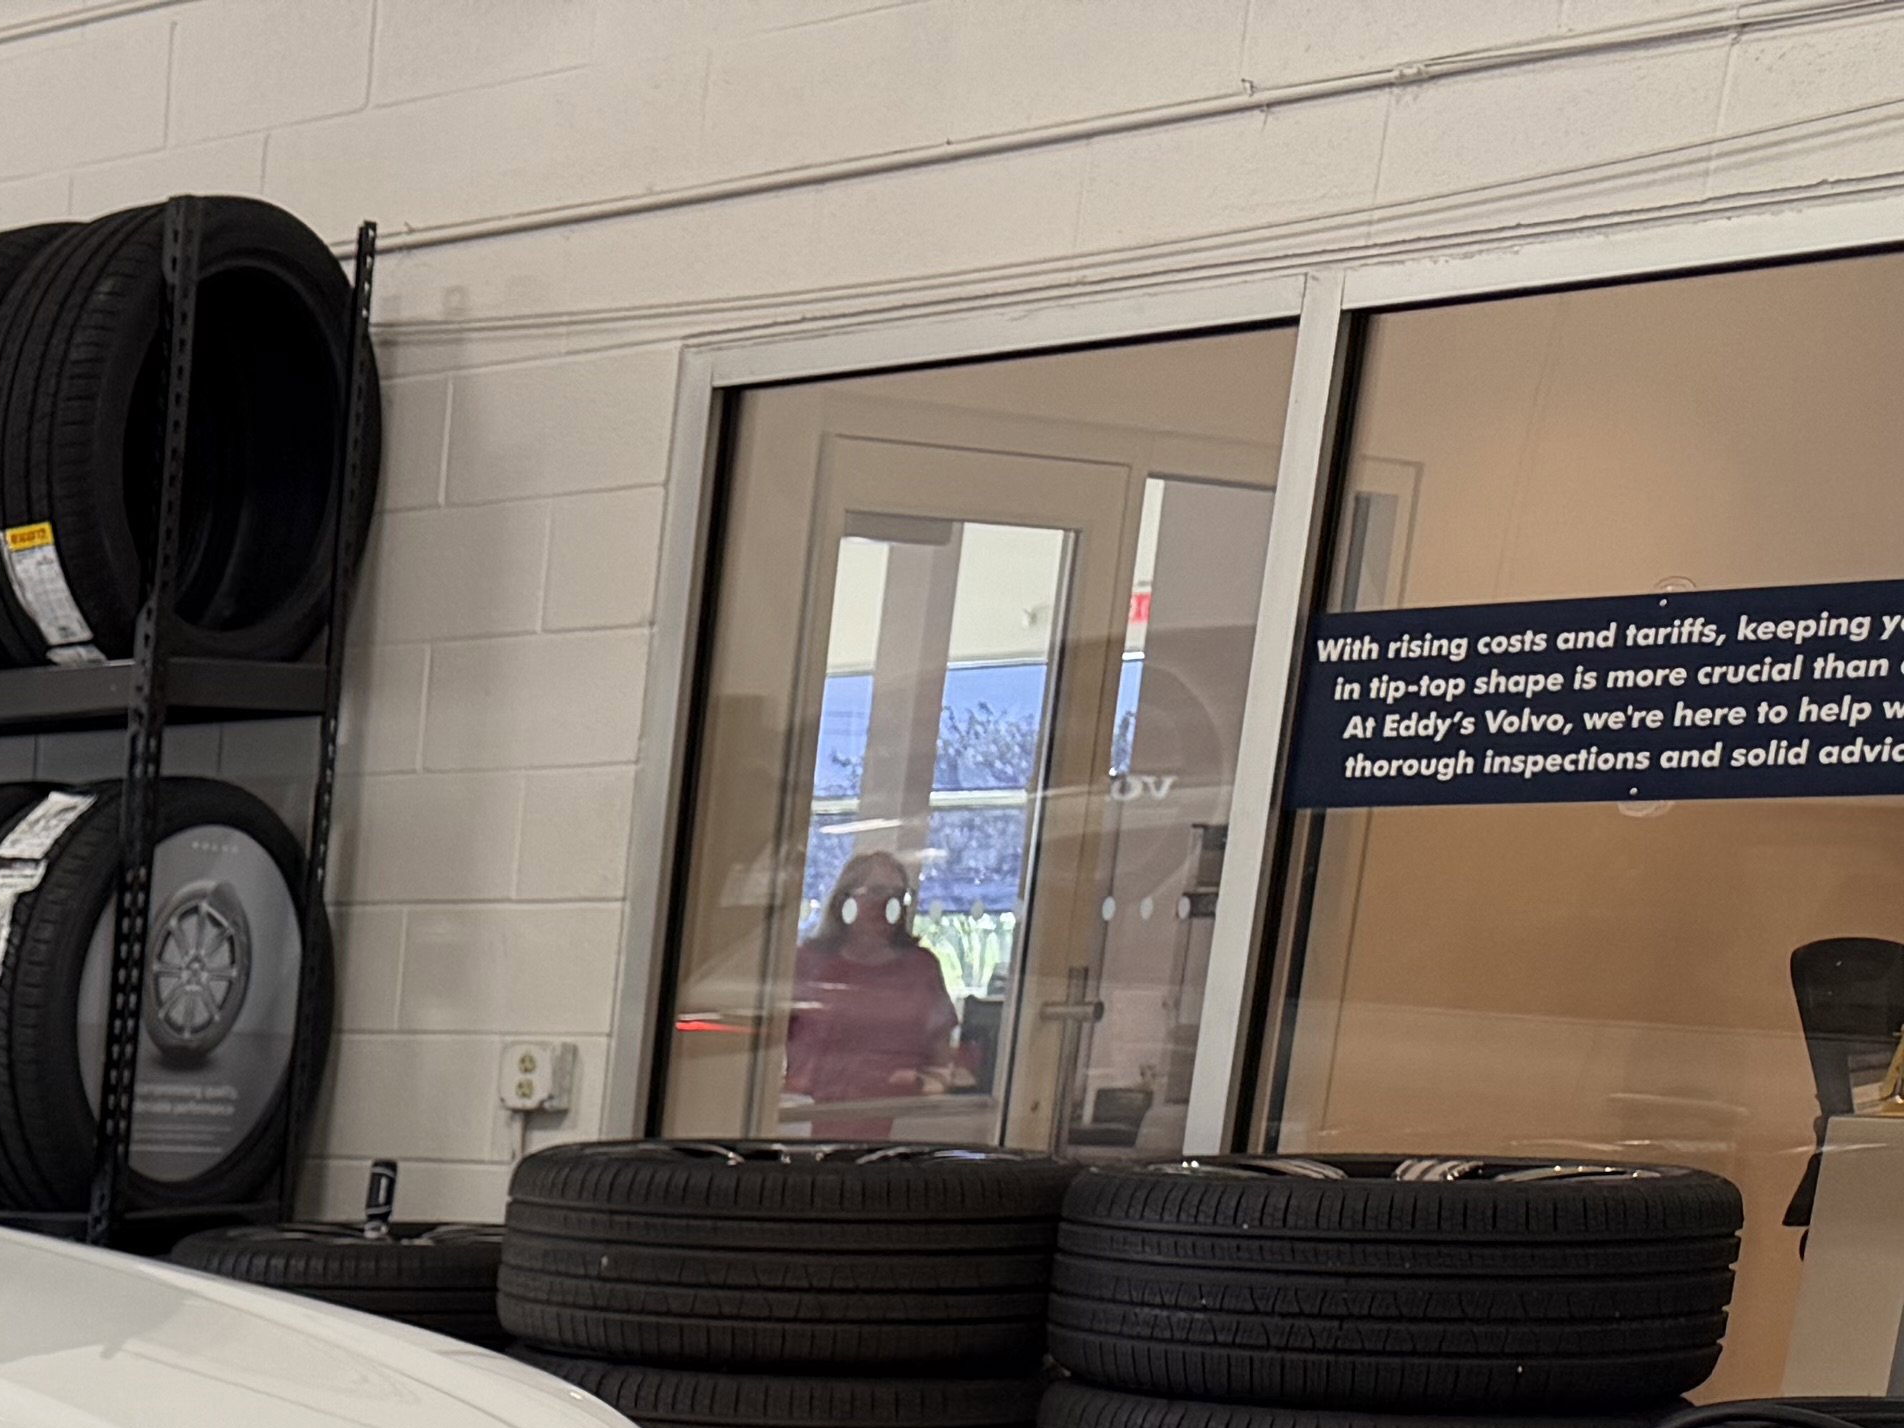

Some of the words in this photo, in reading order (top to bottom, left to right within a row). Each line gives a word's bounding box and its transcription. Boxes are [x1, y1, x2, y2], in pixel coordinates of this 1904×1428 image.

[1317, 635, 1380, 662] With
[1387, 632, 1469, 662] rising
[1476, 629, 1548, 655] costs
[1556, 621, 1617, 651] and
[1625, 617, 1727, 647] tariffs,
[1737, 610, 1872, 645] keeping
[1880, 614, 1904, 641] y
[1334, 676, 1361, 701] in
[1369, 674, 1466, 705] tip-top
[1473, 668, 1565, 699] shape
[1573, 665, 1598, 690] is
[1606, 667, 1688, 688] more
[1697, 654, 1804, 685] crucial
[1813, 652, 1889, 680] than
[1342, 715, 1376, 739] At
[1484, 707, 1573, 736] Volvo,
[1583, 704, 1664, 730] we're
[1673, 700, 1747, 727] here
[1757, 701, 1789, 724] to
[1798, 694, 1872, 727] help
[1345, 749, 1475, 781] thorough
[1483, 745, 1651, 779] inspections
[1659, 741, 1723, 769] and
[1730, 738, 1810, 767] solid
